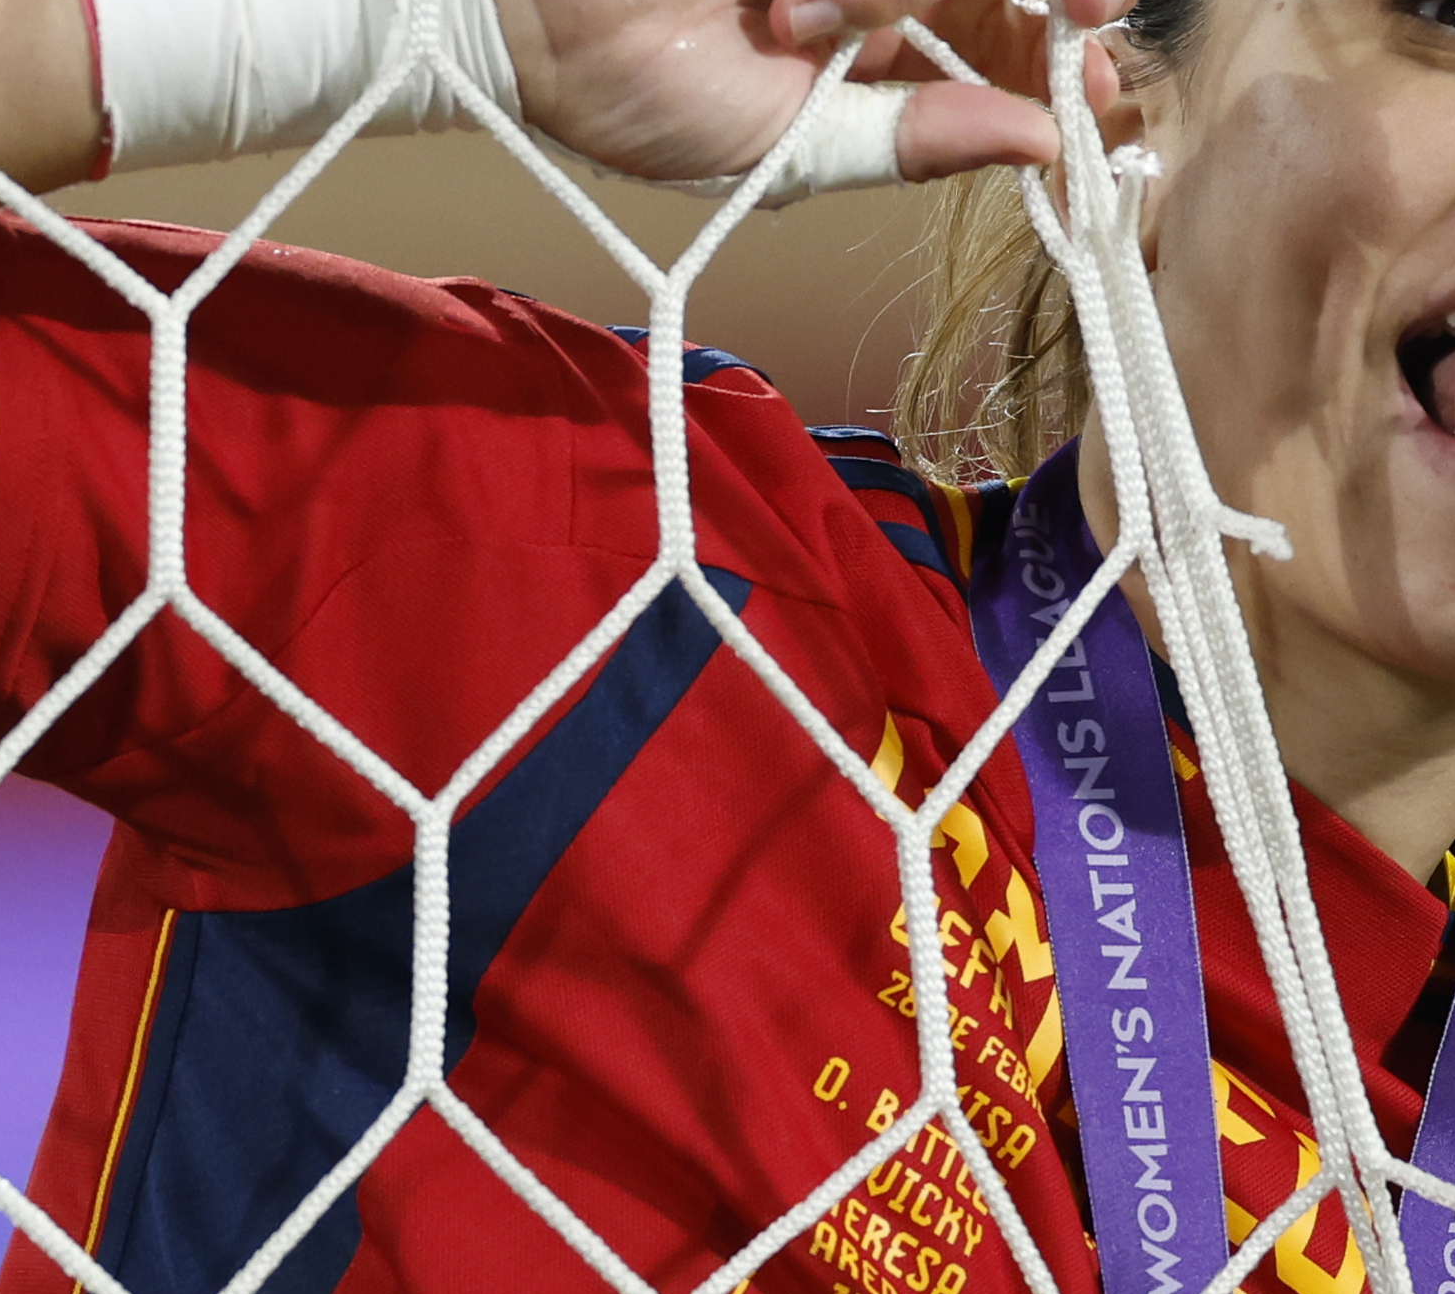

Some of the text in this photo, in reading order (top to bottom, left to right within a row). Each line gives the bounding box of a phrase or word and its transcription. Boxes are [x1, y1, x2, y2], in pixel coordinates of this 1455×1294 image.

[1057, 716, 1153, 991] NATIONS
[812, 1056, 847, 1111] O.
[866, 1159, 983, 1258] VICKY
